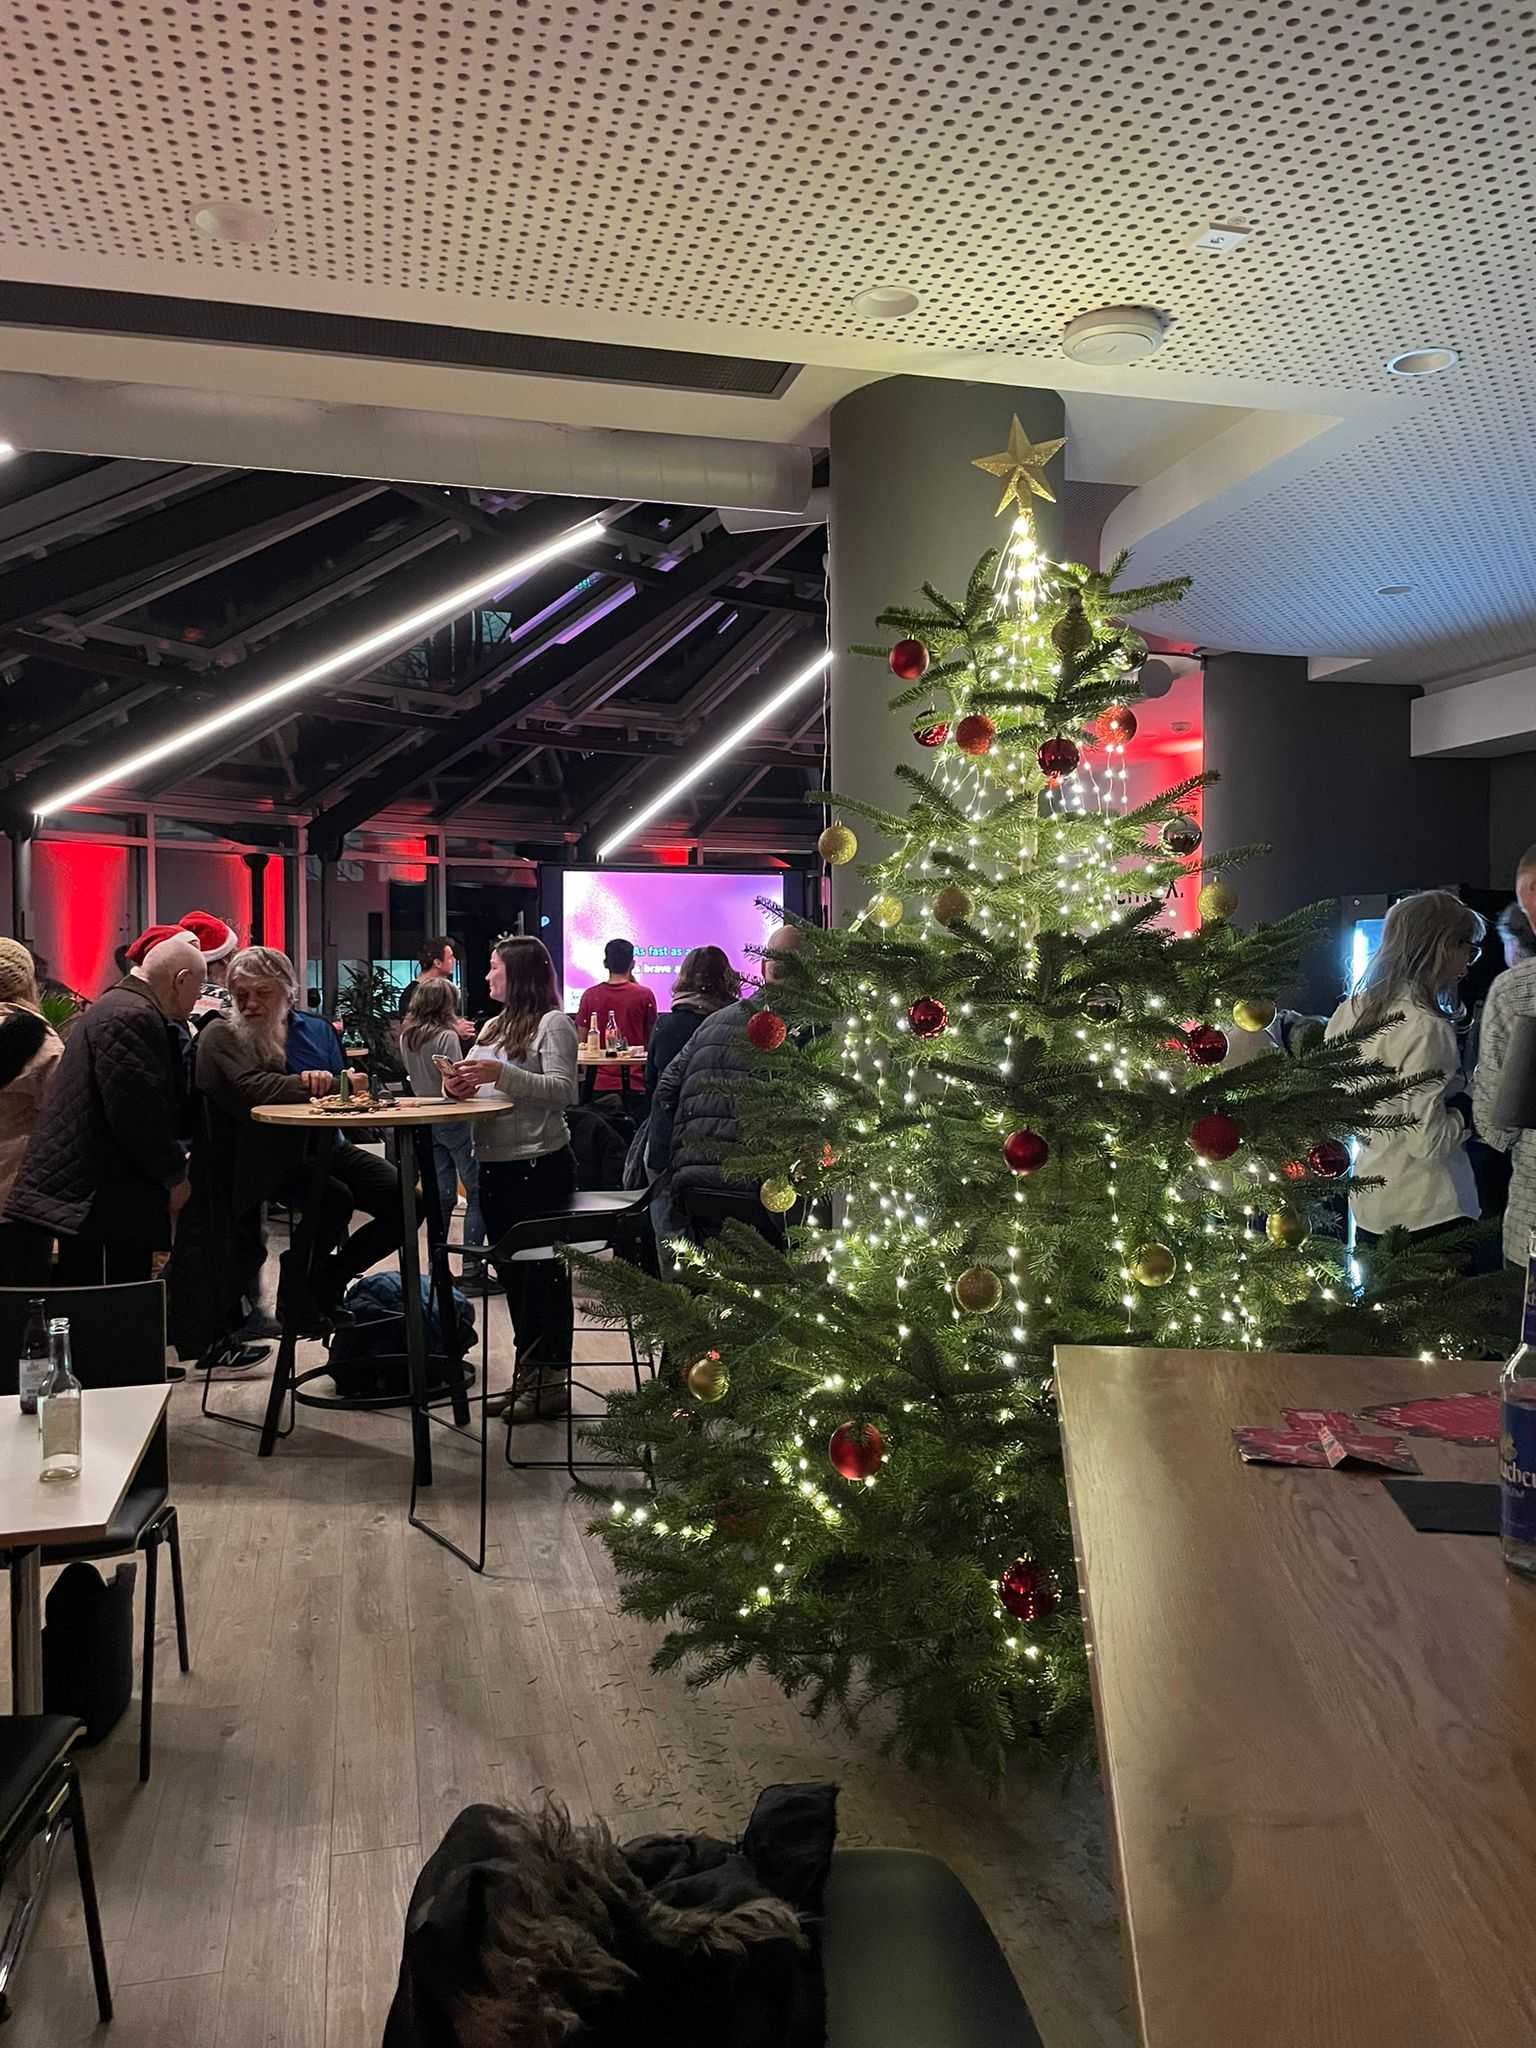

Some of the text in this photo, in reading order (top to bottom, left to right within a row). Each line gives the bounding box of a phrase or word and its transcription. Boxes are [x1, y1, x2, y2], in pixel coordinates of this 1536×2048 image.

[633, 946, 646, 957] As
[648, 945, 668, 957] fast
[671, 947, 682, 957] as
